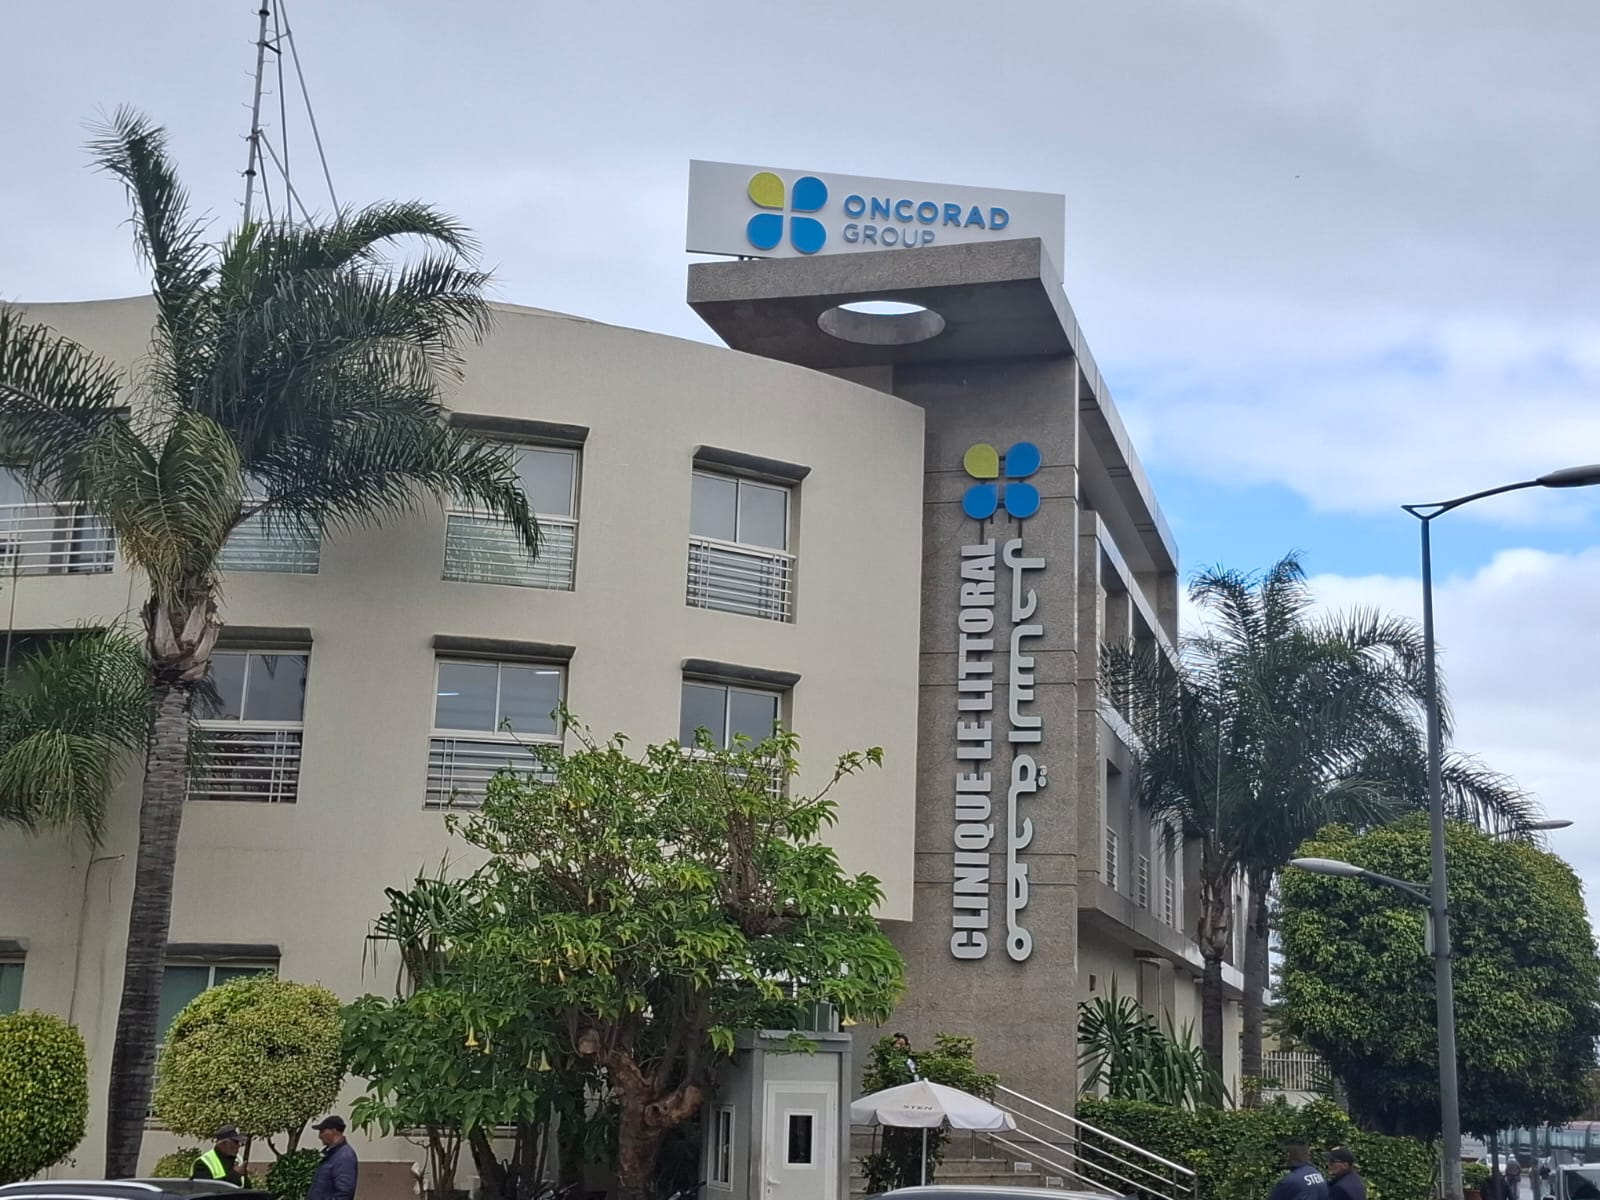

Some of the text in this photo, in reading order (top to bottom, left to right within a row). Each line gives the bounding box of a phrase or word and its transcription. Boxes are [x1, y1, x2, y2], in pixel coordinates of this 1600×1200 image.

[843, 223, 936, 248] GROUP
[844, 194, 1010, 231] ONCORAD
[951, 538, 996, 959] CLINIQUE LE LITTORAL
[1003, 538, 1048, 961] مصحة الساحل
